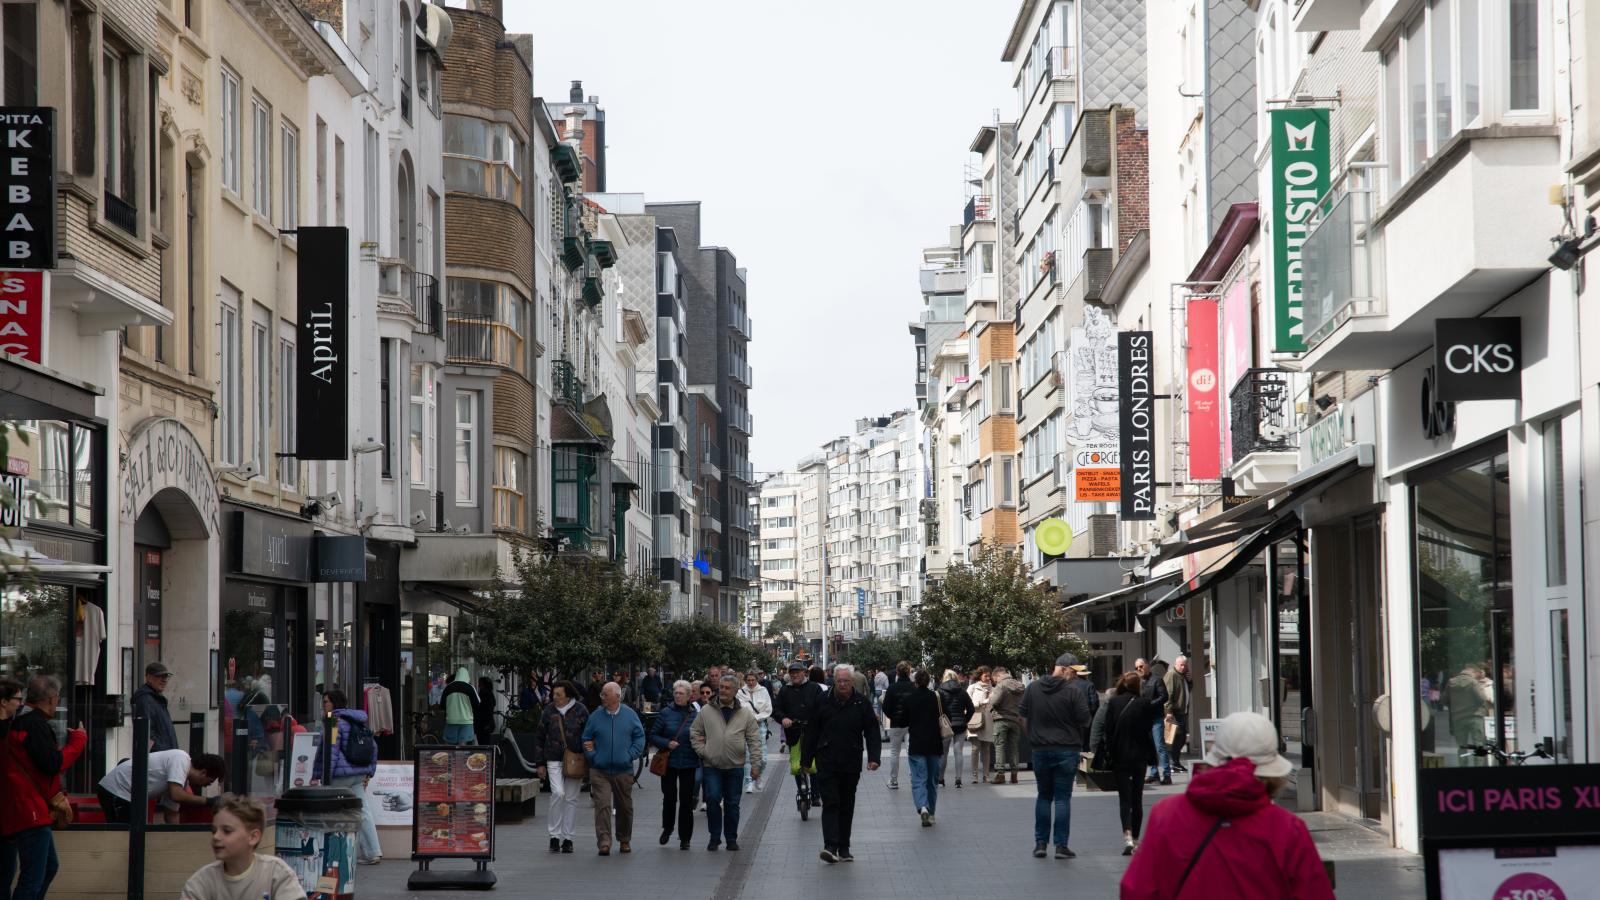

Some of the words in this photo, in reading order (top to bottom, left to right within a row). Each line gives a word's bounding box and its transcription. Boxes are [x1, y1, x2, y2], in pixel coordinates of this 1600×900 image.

[5, 129, 35, 259] KEBAB
[1130, 335, 1150, 443] LONDRES
[1444, 343, 1515, 373] CKS
[1133, 450, 1151, 513] PARIS
[1438, 789, 1475, 813] ICI
[1483, 787, 1562, 811] PARIS
